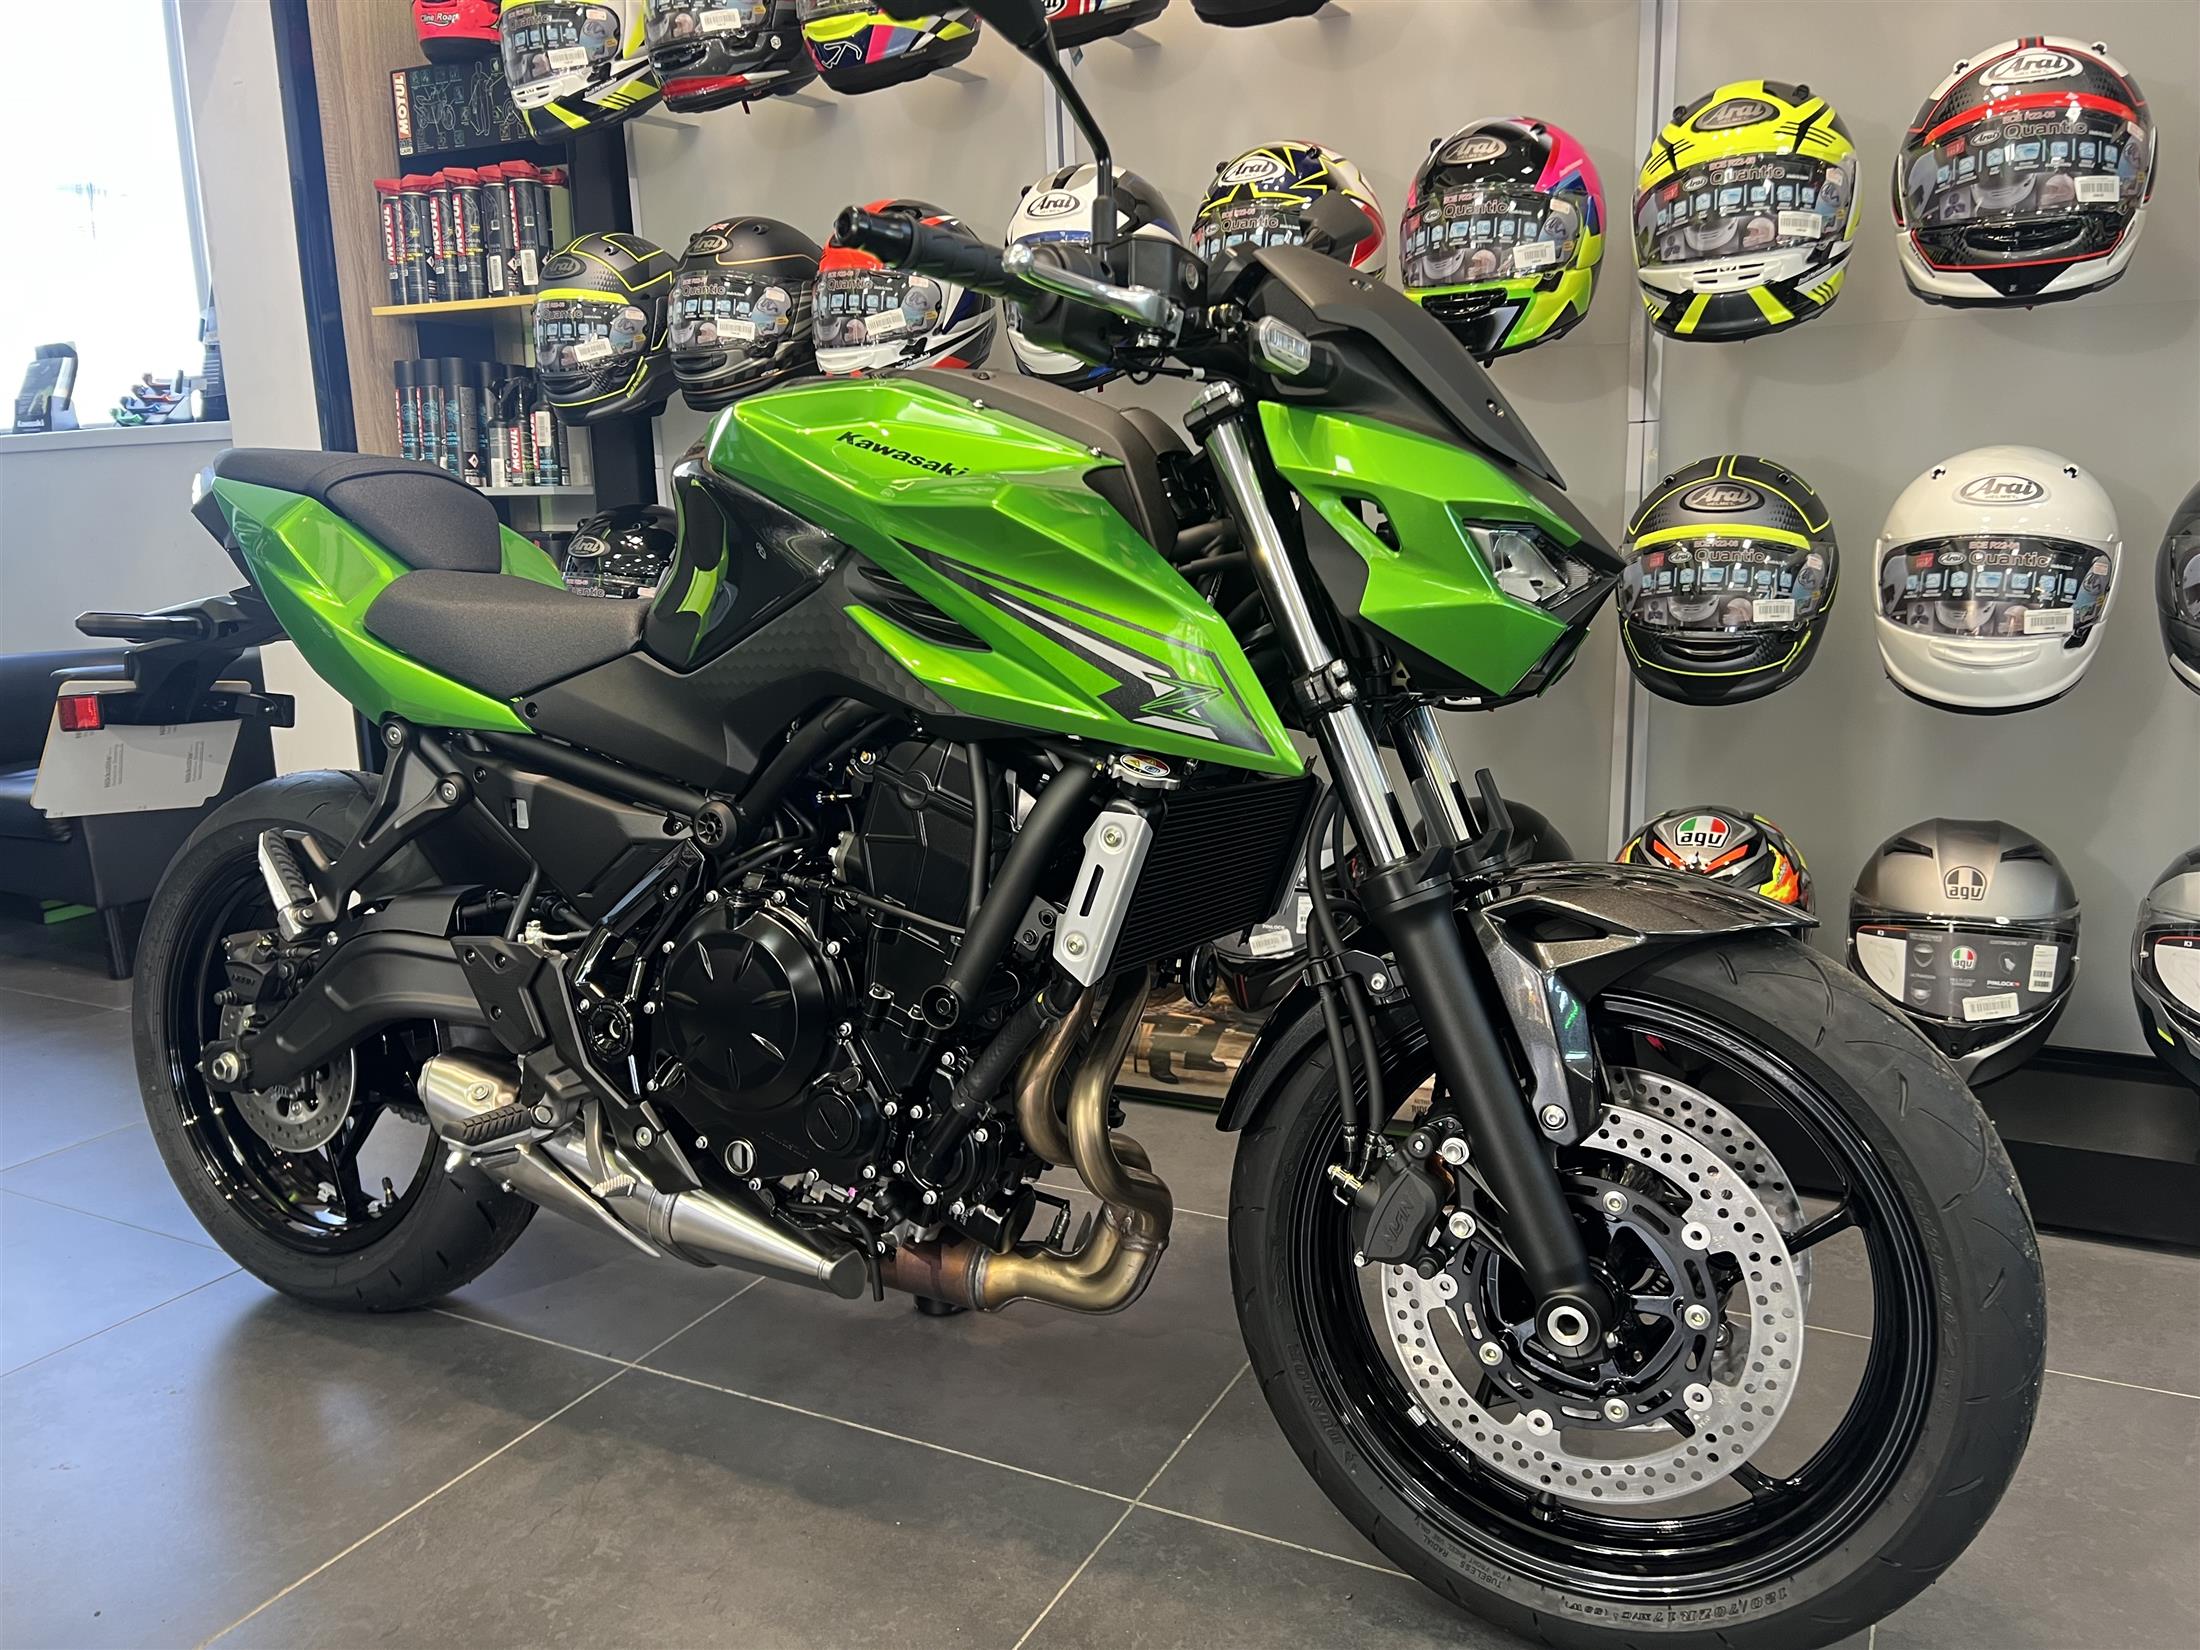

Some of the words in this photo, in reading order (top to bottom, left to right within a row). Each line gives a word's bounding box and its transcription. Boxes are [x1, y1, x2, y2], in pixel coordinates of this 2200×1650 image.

[1995, 57, 2064, 79] Arai
[394, 75, 409, 134] MOTUL
[1702, 103, 1764, 125] Arai
[2003, 120, 2088, 140] Quantic
[1446, 140, 1499, 159] Arai
[1226, 162, 1270, 179] Arai
[1710, 163, 1785, 185] Quantic
[1033, 196, 1072, 214] Arai
[1443, 200, 1509, 219] Quantic
[430, 200, 441, 256] MOTUL
[452, 197, 464, 253] MOTUL
[1221, 215, 1280, 232] Quantic
[383, 206, 395, 261] MOTUL
[694, 236, 720, 249] Arai
[682, 283, 727, 296] Quantic
[510, 429, 521, 470] MOTUL
[836, 431, 970, 476] Kawasaki
[1693, 487, 1750, 504] Arai
[1967, 478, 2033, 496] Arai
[571, 538, 599, 552] Arai
[1694, 548, 1766, 563] Quantic
[1969, 550, 2049, 568] Quantic
[1681, 831, 1722, 846] agv
[1950, 886, 1981, 900] agv
[1986, 979, 2014, 987] PINLOCK
[1423, 1534, 1449, 1558] RADIAL
[1459, 1561, 1504, 1589] TUBELESS
